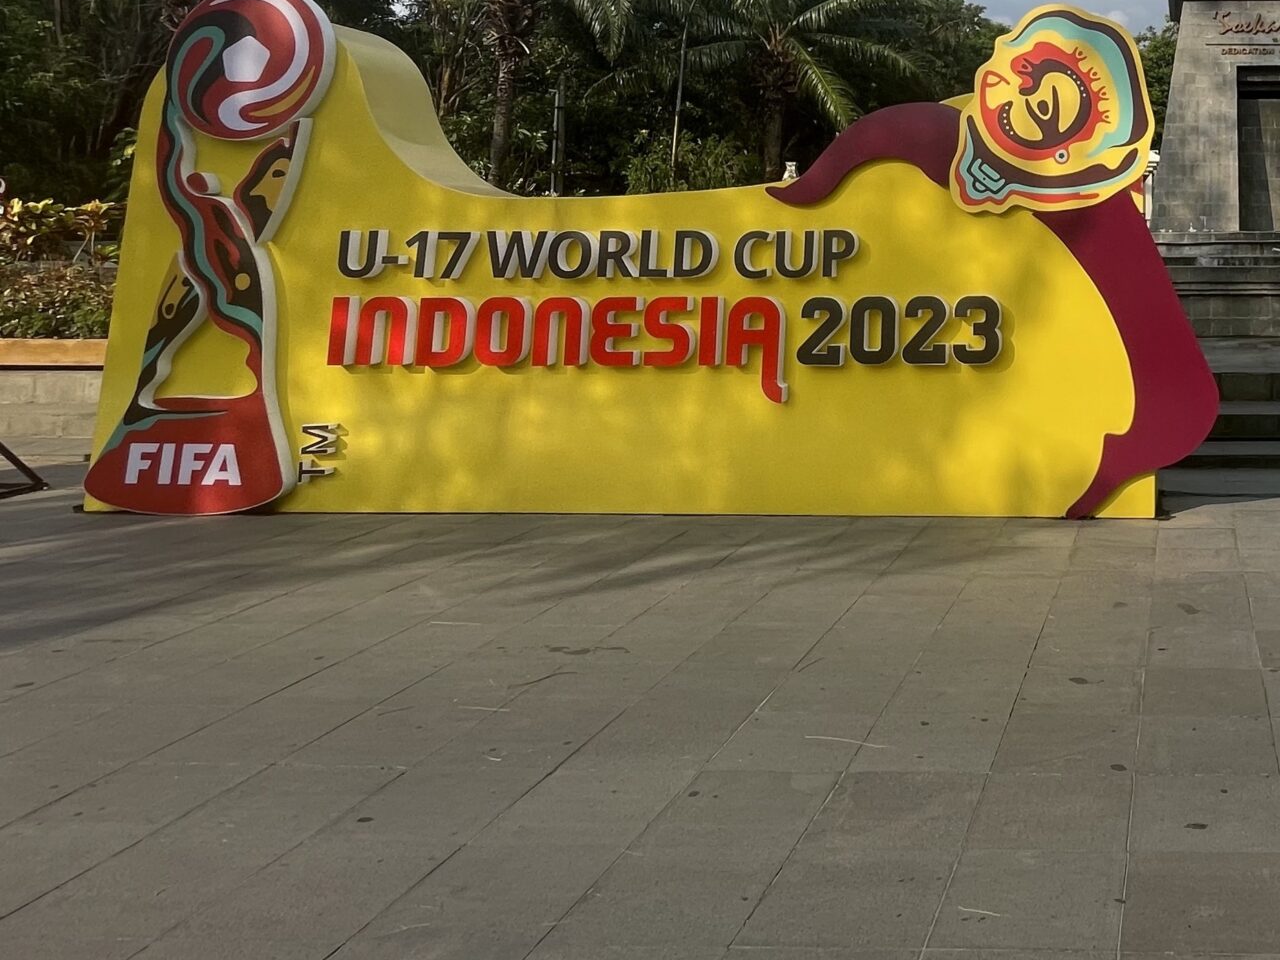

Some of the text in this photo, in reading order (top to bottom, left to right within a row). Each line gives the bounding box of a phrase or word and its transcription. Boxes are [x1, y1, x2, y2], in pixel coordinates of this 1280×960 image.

[1221, 48, 1275, 56] DEDICATION
[337, 229, 860, 280] U-17 WORLD CUP
[327, 295, 1003, 405] INDONESIA 2023
[124, 442, 242, 486] FIFA
[298, 423, 339, 484] TM
